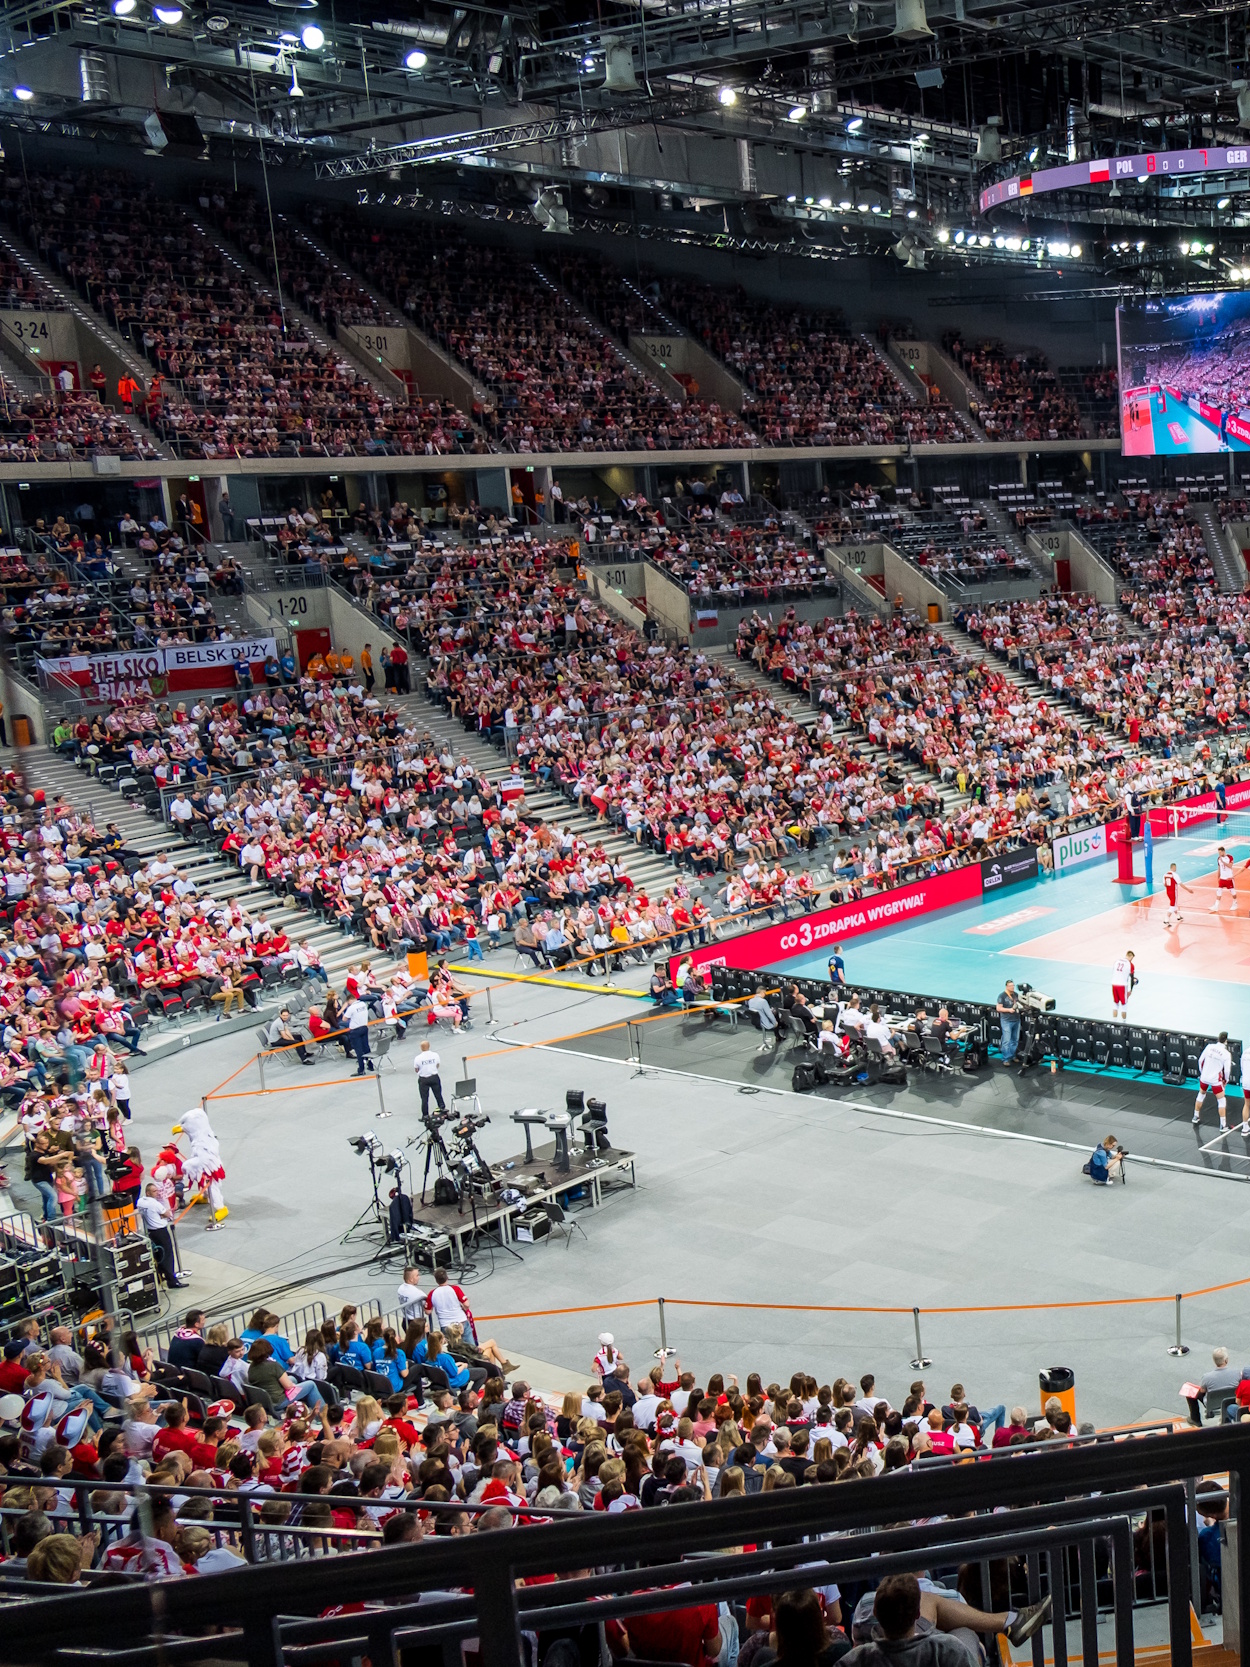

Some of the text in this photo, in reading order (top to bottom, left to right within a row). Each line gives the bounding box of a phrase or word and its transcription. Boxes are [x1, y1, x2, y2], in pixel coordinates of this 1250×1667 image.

[1116, 160, 1133, 174] POL
[1147, 155, 1156, 172] 8
[1227, 150, 1248, 164] GER
[14, 321, 48, 339] 3-24
[365, 336, 388, 350] 3-01
[651, 344, 672, 357] 3-02
[847, 551, 866, 564] 1-02
[606, 570, 626, 586] 1-01
[277, 596, 307, 616] 1-20
[176, 649, 227, 665] BELSK
[89, 656, 158, 684] BIELSKO
[1060, 837, 1090, 865] plus
[985, 875, 1002, 886] ORLEN
[780, 933, 798, 950] CO
[800, 923, 813, 947] 3
[814, 911, 866, 940] ZDRAPKA
